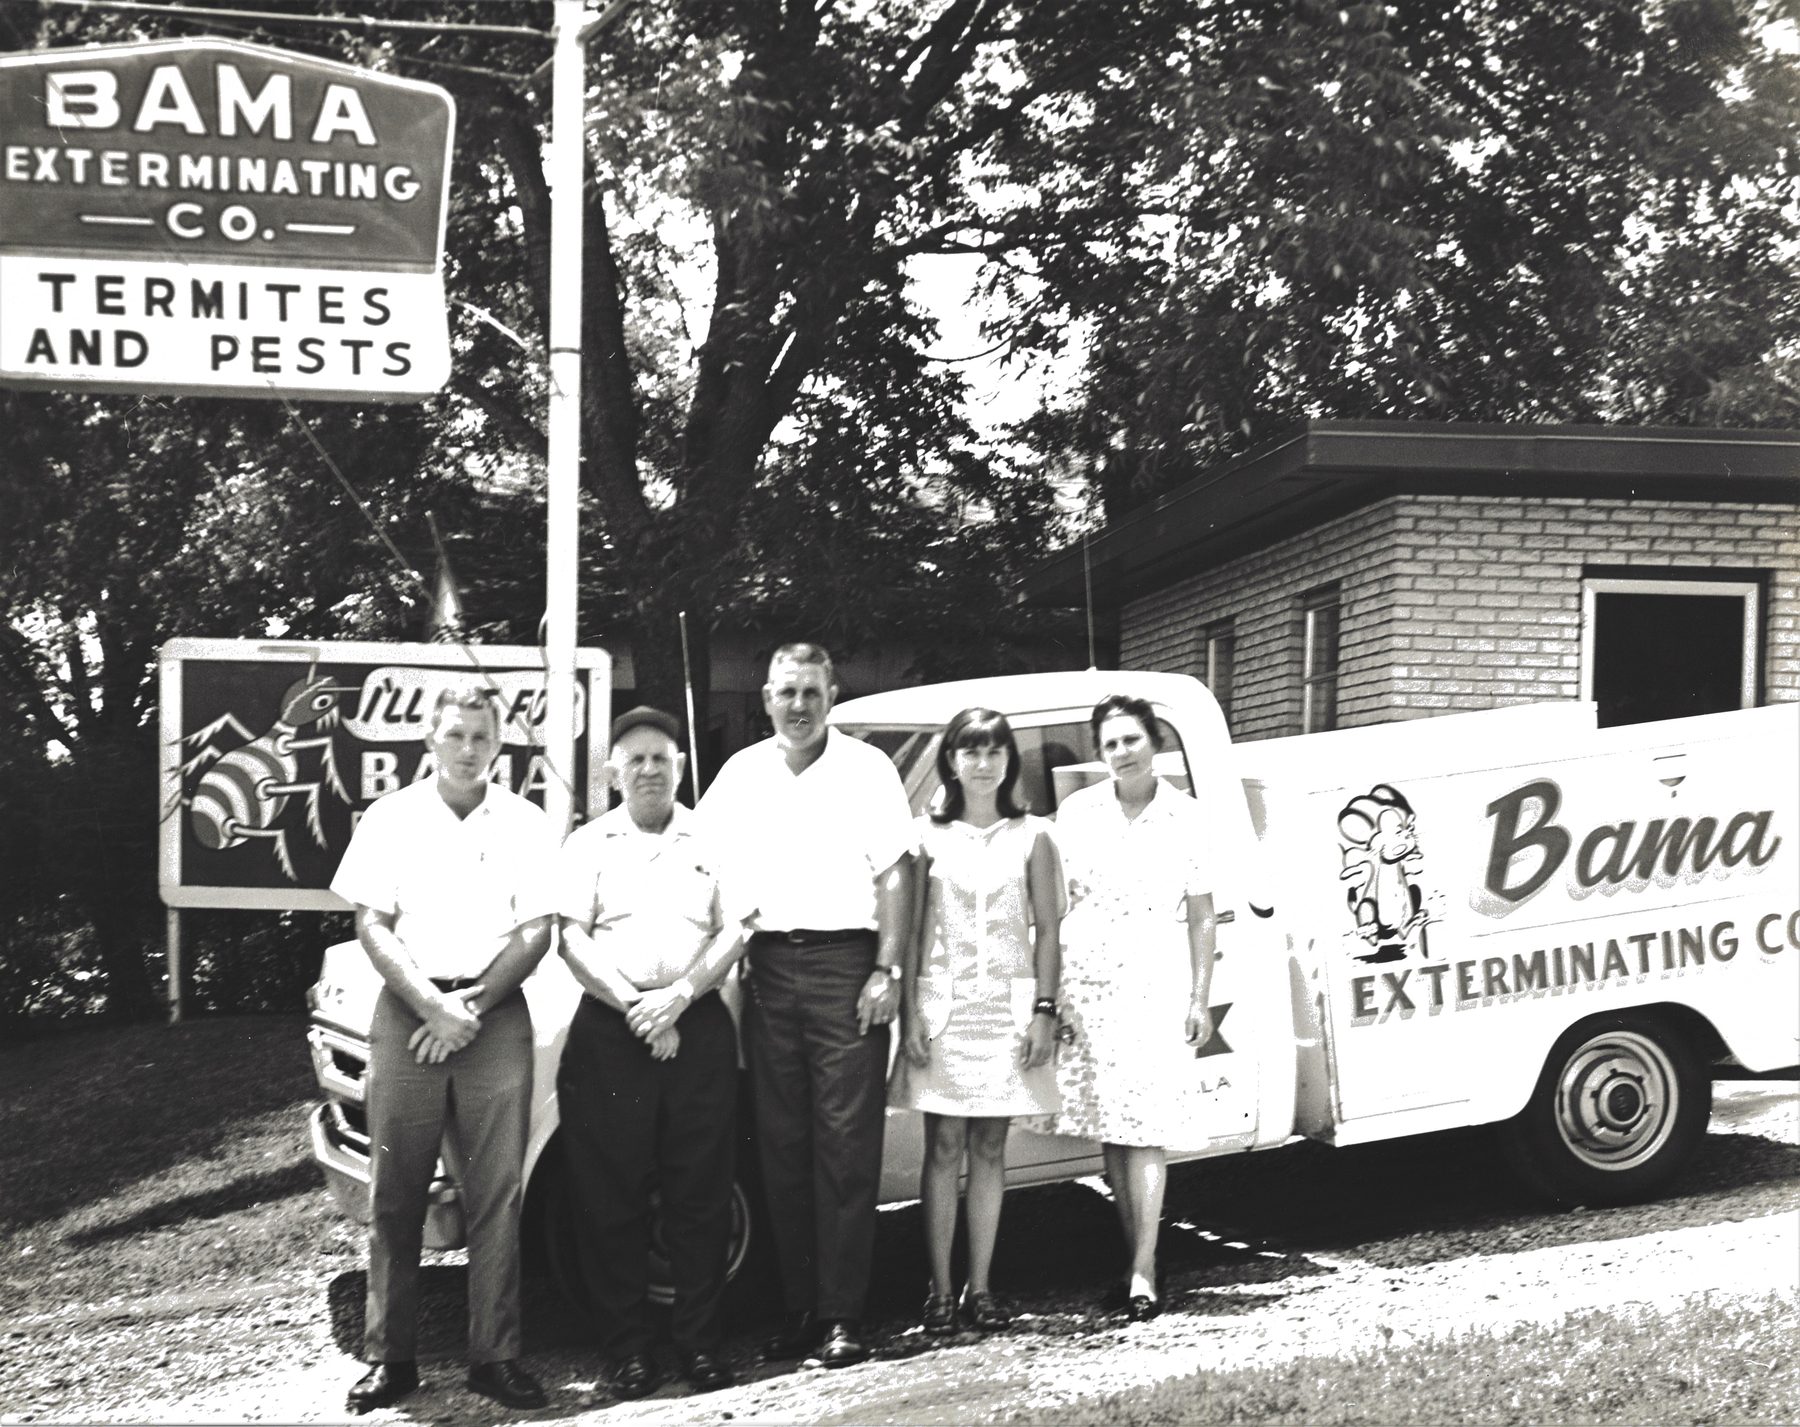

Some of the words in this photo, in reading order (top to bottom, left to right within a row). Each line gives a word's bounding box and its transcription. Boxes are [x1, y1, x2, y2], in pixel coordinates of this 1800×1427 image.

[46, 64, 377, 146] BAMA
[6, 146, 421, 201] EXTERMINATING
[166, 202, 275, 241] CO.
[38, 273, 391, 326] TERMITES
[25, 328, 149, 368] AND
[211, 335, 412, 376] PESTS
[361, 677, 423, 724] I'LL
[1486, 776, 1782, 902] Bama
[1352, 921, 1739, 1018] EXTERMINATING
